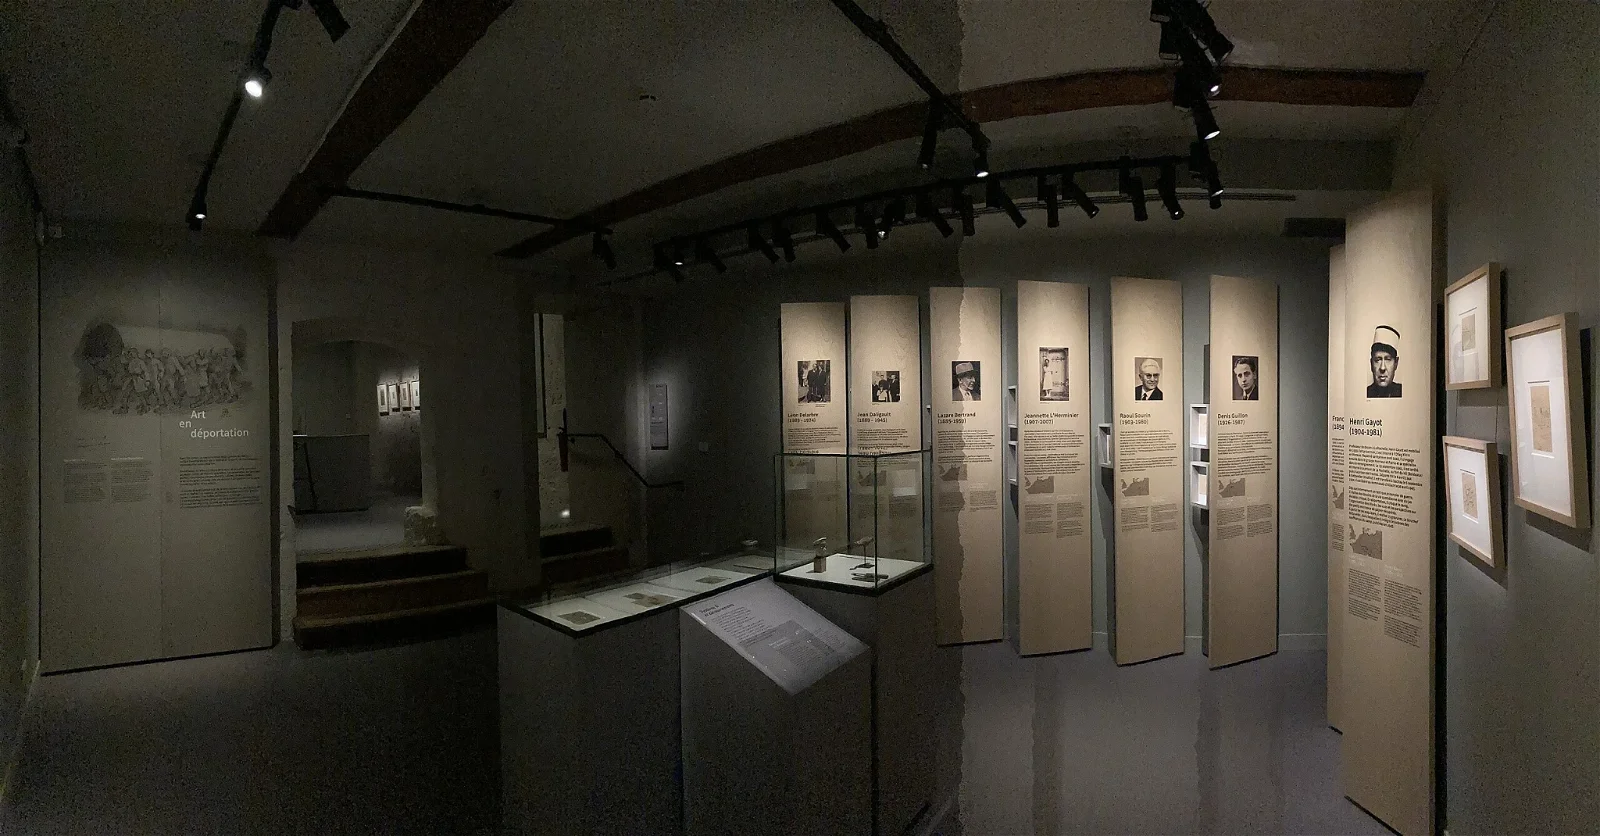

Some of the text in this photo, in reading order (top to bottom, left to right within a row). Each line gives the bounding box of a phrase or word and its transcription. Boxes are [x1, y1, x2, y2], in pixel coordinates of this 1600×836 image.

[190, 410, 206, 419] Art
[179, 419, 192, 428] en
[1365, 418, 1383, 427] Gayot
[190, 427, 249, 439] déportation
[1349, 426, 1383, 437] (1904-1981)
